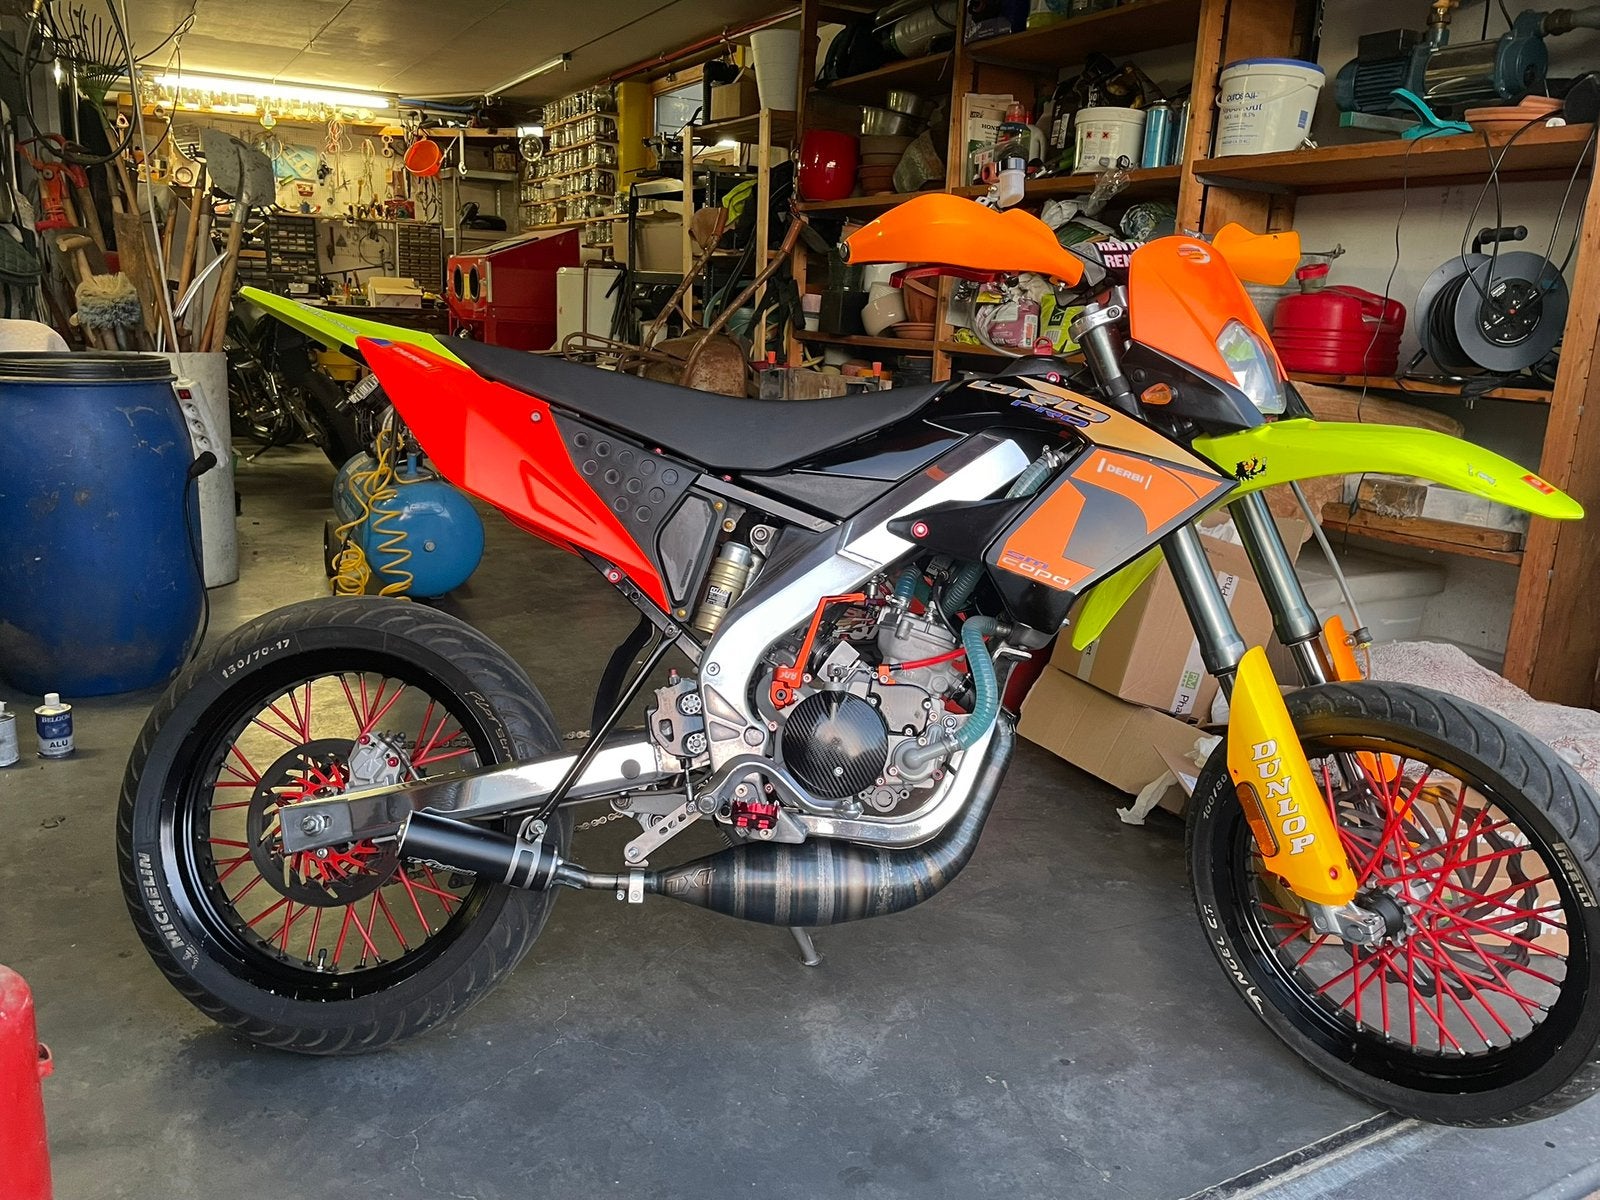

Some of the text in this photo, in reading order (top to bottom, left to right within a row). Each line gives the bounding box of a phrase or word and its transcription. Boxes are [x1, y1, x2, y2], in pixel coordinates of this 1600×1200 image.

[1010, 399, 1091, 428] PRO
[1106, 463, 1145, 484] DERBI
[222, 638, 291, 679] 130/70-17
[49, 739, 68, 749] ALU
[1202, 773, 1229, 820] 100/80
[1251, 739, 1316, 856] DUNLOP
[1552, 842, 1598, 908] PIRELLI
[137, 852, 185, 950] MICHELIN
